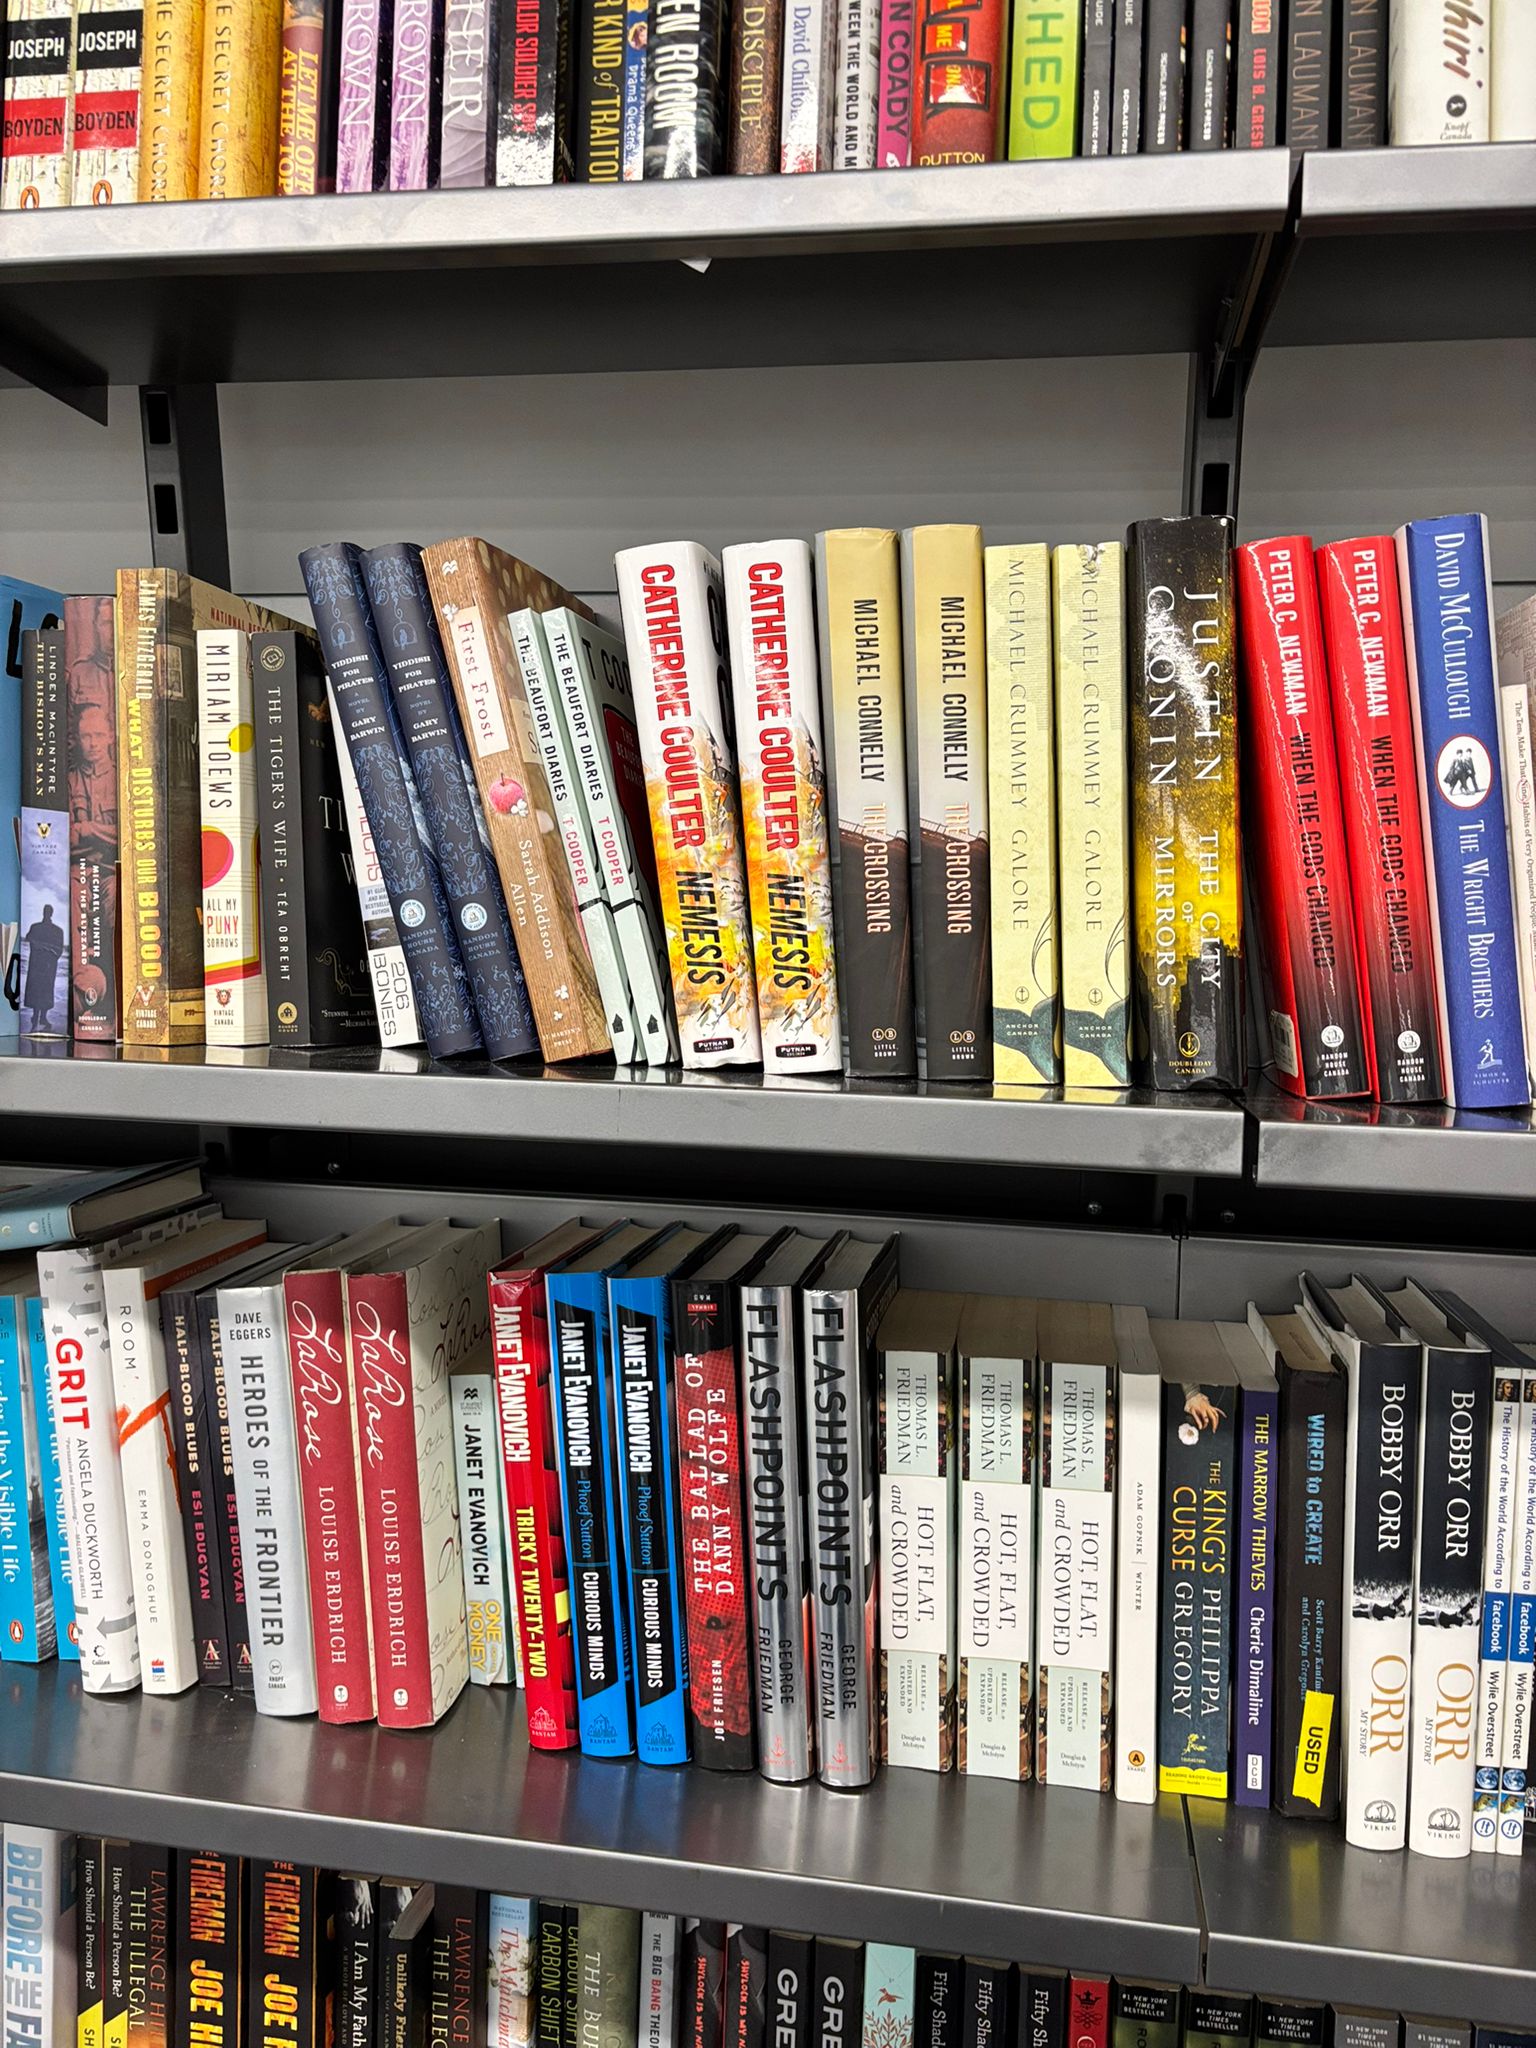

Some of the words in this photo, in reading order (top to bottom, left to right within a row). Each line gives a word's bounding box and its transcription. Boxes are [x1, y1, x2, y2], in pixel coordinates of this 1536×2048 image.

[7, 38, 65, 60] JOSEPH
[283, 46, 298, 81] AT
[592, 15, 623, 67] KIND
[153, 31, 172, 117] SECRET
[299, 48, 318, 100] LET
[740, 7, 766, 133] DISCIPLE
[885, 33, 911, 137] COADY
[3, 115, 63, 138] BOYDEN
[280, 84, 296, 137] THE
[296, 100, 316, 142] ME
[278, 140, 295, 196] TOP
[294, 144, 316, 195] OFF
[919, 152, 985, 166] DUTTON
[1434, 532, 1466, 589] DAVID
[641, 562, 691, 720] CATHERINE
[854, 599, 880, 686] MICHAEL
[1008, 560, 1026, 673] MICHAEL
[36, 641, 45, 674] THE
[48, 645, 57, 703] LINDEN
[205, 644, 230, 724] MIRIAM
[457, 621, 480, 675] First
[472, 682, 494, 741] Frost
[1147, 584, 1178, 786] CRONIN
[1183, 588, 1222, 783] JUSTIN
[36, 680, 45, 755] BISHOP'S
[129, 699, 145, 759] WHAT
[267, 686, 282, 728] THE
[48, 712, 57, 794] MACINTYRE
[857, 696, 885, 783] CONNELLY
[1009, 683, 1029, 807] CRUMMEY
[36, 763, 44, 797] MAN
[207, 740, 232, 810] TOEWS
[270, 736, 284, 810] TIGER'S
[660, 727, 708, 849] COULTER
[133, 767, 156, 851] DISTURBS
[271, 820, 287, 869] WIFE
[1198, 830, 1220, 896] THE
[1458, 819, 1485, 859] THE
[79, 858, 87, 884] INTO
[91, 865, 101, 914] MICHAEL
[135, 859, 156, 887] OUR
[518, 839, 537, 887] Sarah
[528, 891, 555, 960] Addison
[864, 842, 892, 934] CROSSING
[1011, 829, 1029, 930] GALORE
[1462, 859, 1490, 926] WRIGHT
[206, 899, 223, 912] ALL
[225, 899, 238, 912] MY
[206, 915, 238, 935] PUNY
[510, 882, 529, 928] Allen
[676, 871, 725, 985] NEMESIS
[1153, 837, 1178, 988] MIRRORS
[80, 910, 88, 966] BLIZZARD
[92, 917, 102, 958] WINTER
[139, 891, 162, 978] BLOOD
[206, 938, 238, 948] SORROWS
[278, 924, 290, 981] OBREHT
[1198, 910, 1223, 990] CITY
[1466, 930, 1495, 1021] BROTHERS
[1005, 1023, 1039, 1031] ANCHOR
[1168, 1060, 1212, 1068] DOUBLEDAY
[1175, 1067, 1207, 1075] CANADA
[229, 1326, 272, 1341] EGGERS
[234, 1312, 263, 1325] DAVE
[55, 1338, 90, 1429] GRIT
[175, 1314, 193, 1417] HALF-BLOOD
[185, 1421, 199, 1474] BLUES
[684, 1353, 706, 1388] OF
[240, 1354, 270, 1449] HEROES
[896, 1367, 912, 1466] FRIEDMAN
[915, 1375, 928, 1442] THOMAS
[1255, 1413, 1269, 1444] THE
[1502, 1405, 1512, 1423] The
[464, 1425, 484, 1480] JANET
[706, 1389, 728, 1493] WOLFE
[1379, 1382, 1406, 1484] BOBBY
[1499, 1427, 1511, 1460] History
[76, 1438, 92, 1498] ANGELA
[252, 1459, 269, 1480] OF
[688, 1407, 708, 1523] BALLAD
[1209, 1459, 1221, 1485] THE
[1252, 1449, 1269, 1519] MARROW
[1499, 1476, 1509, 1492] the
[137, 1489, 149, 1532] EMMA
[192, 1490, 202, 1517] ESI
[254, 1486, 273, 1517] THE
[380, 1487, 401, 1564] LOUISE
[890, 1484, 907, 1516] and
[1135, 1482, 1143, 1515] ADAM
[1376, 1490, 1403, 1553] ORR
[1498, 1495, 1508, 1523] World
[83, 1503, 103, 1600] DUCKWORTH
[467, 1487, 490, 1587] EVANOVICH
[515, 1506, 538, 1562] TRICKY
[712, 1504, 735, 1596] DANNY
[915, 1506, 936, 1557] HOT,
[1135, 1515, 1143, 1556] GOPNIK
[1170, 1486, 1197, 1572] CURSE
[1202, 1490, 1227, 1574] KING'S
[1494, 1527, 1506, 1575] According
[141, 1539, 159, 1624] DONOGHUE
[194, 1522, 211, 1600] EDUGYAN
[255, 1528, 285, 1646] FRONTIER
[693, 1538, 712, 1595] THE
[890, 1522, 910, 1641] CROWDED
[1250, 1525, 1267, 1592] THIEVES
[385, 1569, 407, 1668] ERDRICH
[916, 1564, 936, 1624] FLAT,
[1134, 1573, 1142, 1613] WINTER
[520, 1566, 547, 1678] TWENTY-TWO
[1172, 1581, 1195, 1720] GREGORY
[1249, 1606, 1265, 1656] Cherie
[1490, 1599, 1504, 1654] facebook
[758, 1627, 774, 1714] FRIEDMAN
[777, 1638, 795, 1705] GEORGE
[1201, 1588, 1221, 1718] PHILIPPA
[712, 1660, 726, 1714] FRIESEN
[1248, 1660, 1263, 1726] Dimaline
[1370, 1653, 1409, 1758] ORR
[1489, 1669, 1501, 1701] Wylie
[712, 1718, 726, 1742] JOE
[1357, 1728, 1368, 1758] STORY
[1359, 1709, 1369, 1727] MY
[1485, 1702, 1500, 1759] Overstreet
[1302, 1725, 1324, 1776] USED
[1364, 1823, 1397, 1831] VIKING
[85, 1859, 95, 1883] How
[7, 1842, 43, 1975] BEFORE
[85, 1887, 96, 1923] Should
[129, 1887, 146, 1931] THE
[190, 1859, 226, 1944] FIREMAN
[86, 1933, 96, 1967] Person
[541, 1921, 561, 1995] CARBON
[7, 1978, 43, 2009] THE
[87, 1971, 96, 1990] Be?
[128, 1941, 144, 2030] ILLEGAL
[190, 1959, 225, 2017] JOE
[1135, 2002, 1155, 2010] TIMES
[539, 1997, 560, 2045] SHIFT
[1123, 2006, 1165, 2017] BESTSELLER
